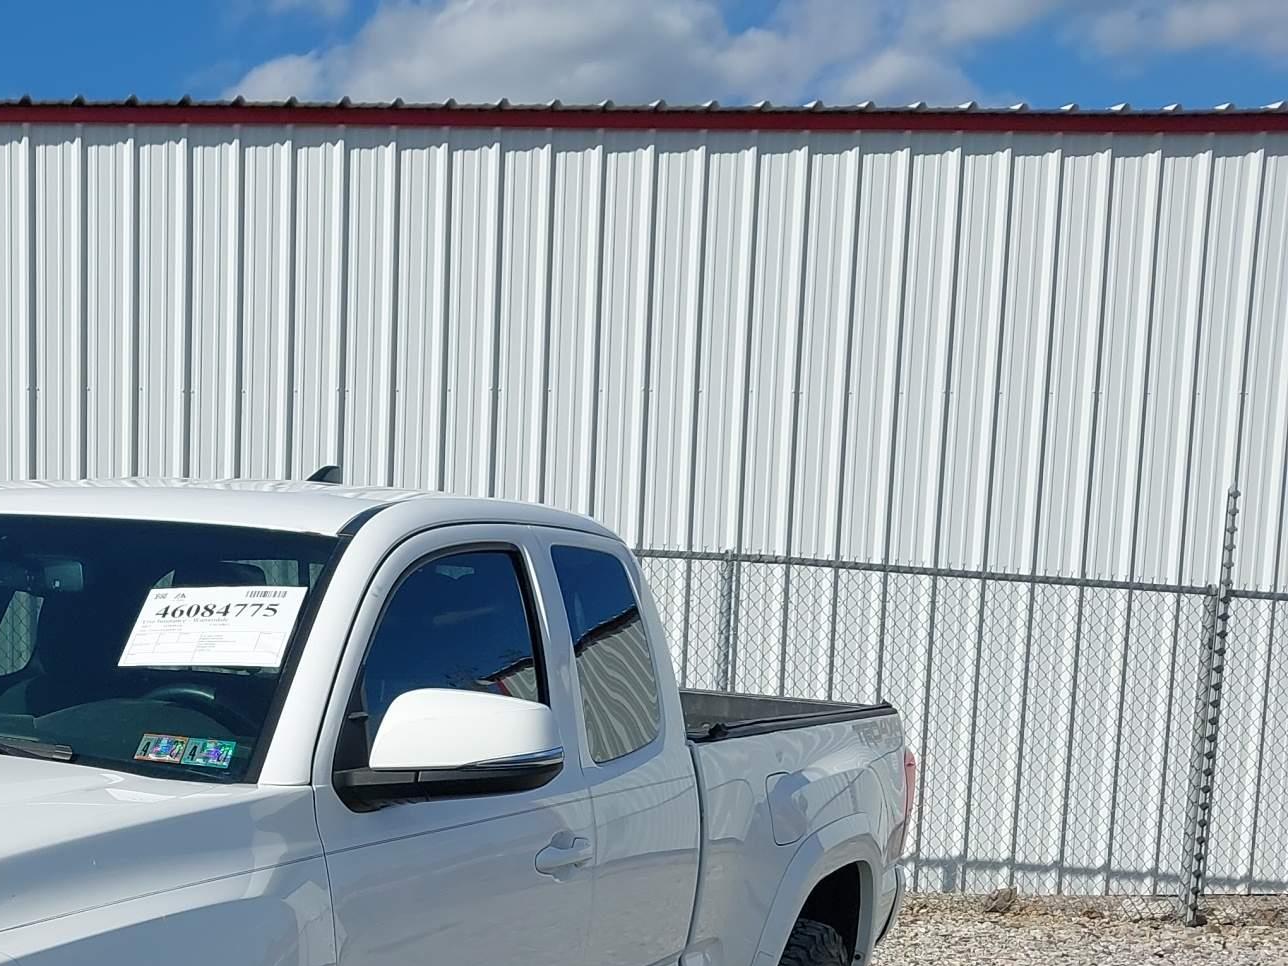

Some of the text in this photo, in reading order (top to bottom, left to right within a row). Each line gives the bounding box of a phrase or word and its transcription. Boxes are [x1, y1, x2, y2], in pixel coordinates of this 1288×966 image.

[155, 603, 280, 618] 46084775
[140, 741, 151, 756] 4
[187, 745, 198, 761] 4
